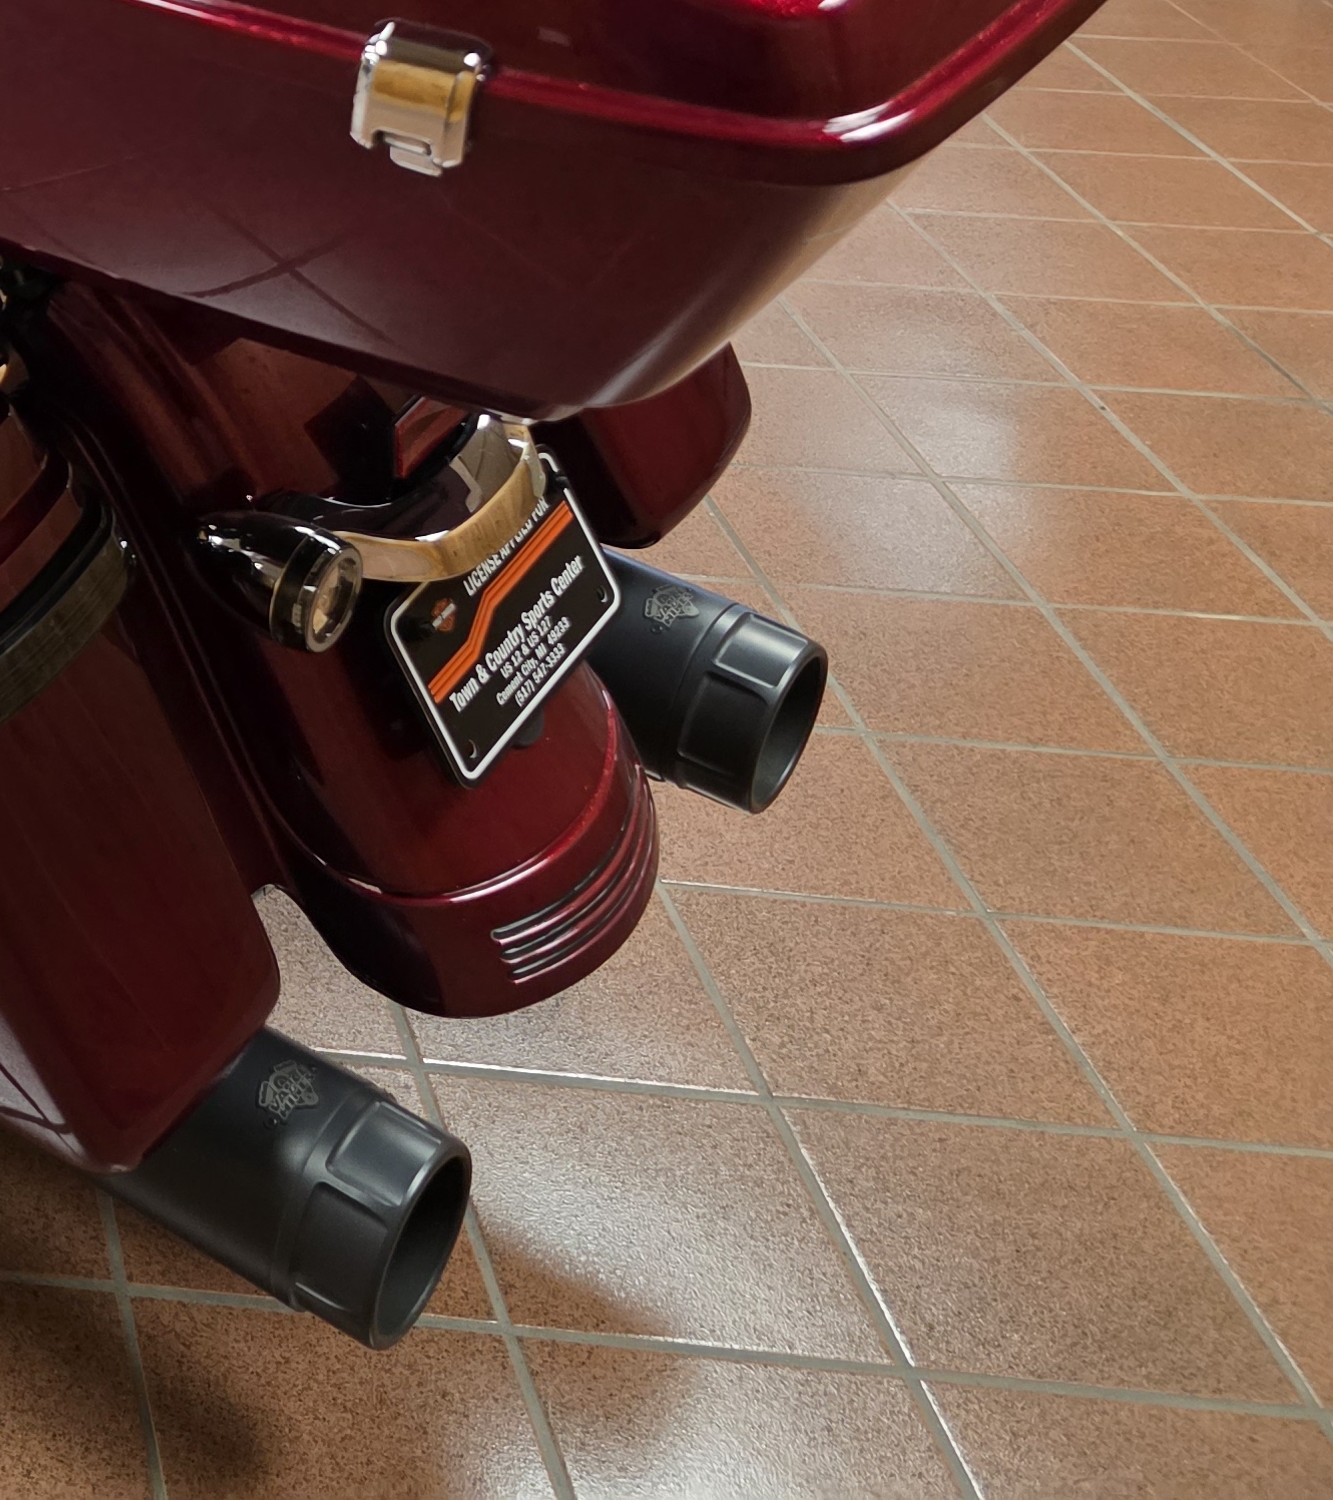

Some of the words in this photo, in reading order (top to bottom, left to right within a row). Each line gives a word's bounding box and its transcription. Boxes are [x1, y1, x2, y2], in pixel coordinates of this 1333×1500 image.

[463, 554, 502, 596] LICENSE
[449, 677, 480, 712] Town
[475, 664, 490, 684] &
[485, 624, 525, 672] Country
[520, 590, 555, 631] Sports
[550, 555, 584, 597] Center
[496, 672, 524, 705] Cement
[534, 643, 547, 660] MI
[547, 617, 571, 645] 49233
[500, 664, 513, 679] US
[511, 651, 523, 666] 12
[526, 632, 540, 648] US
[537, 615, 552, 636] 127
[514, 679, 535, 707] (517)
[532, 643, 566, 684] 547-3333
